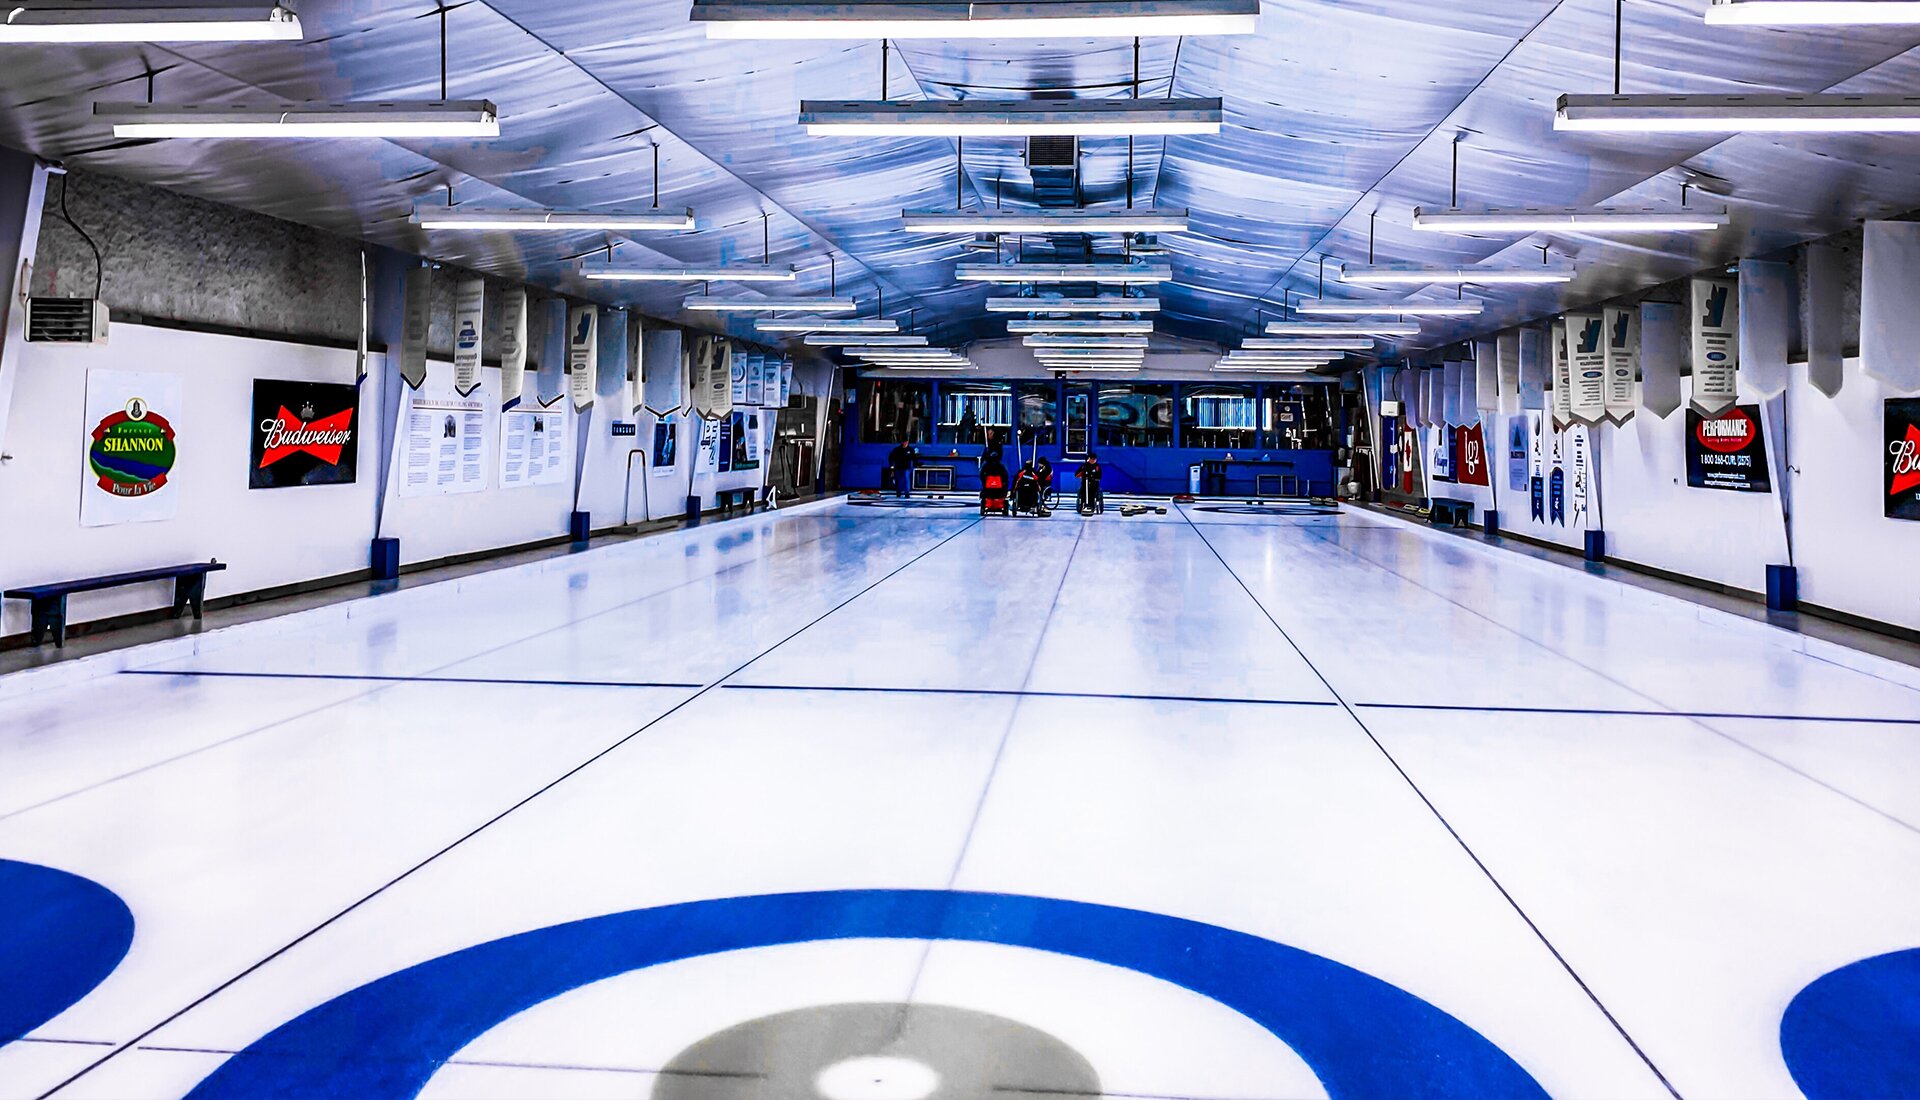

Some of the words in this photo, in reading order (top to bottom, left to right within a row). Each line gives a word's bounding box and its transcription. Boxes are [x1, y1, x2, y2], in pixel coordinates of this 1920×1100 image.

[261, 418, 351, 449] Budweiser
[1702, 419, 1747, 436] PERFORMANCE
[103, 437, 164, 452] SHANNON
[112, 482, 132, 495] Pour
[134, 484, 142, 495] la
